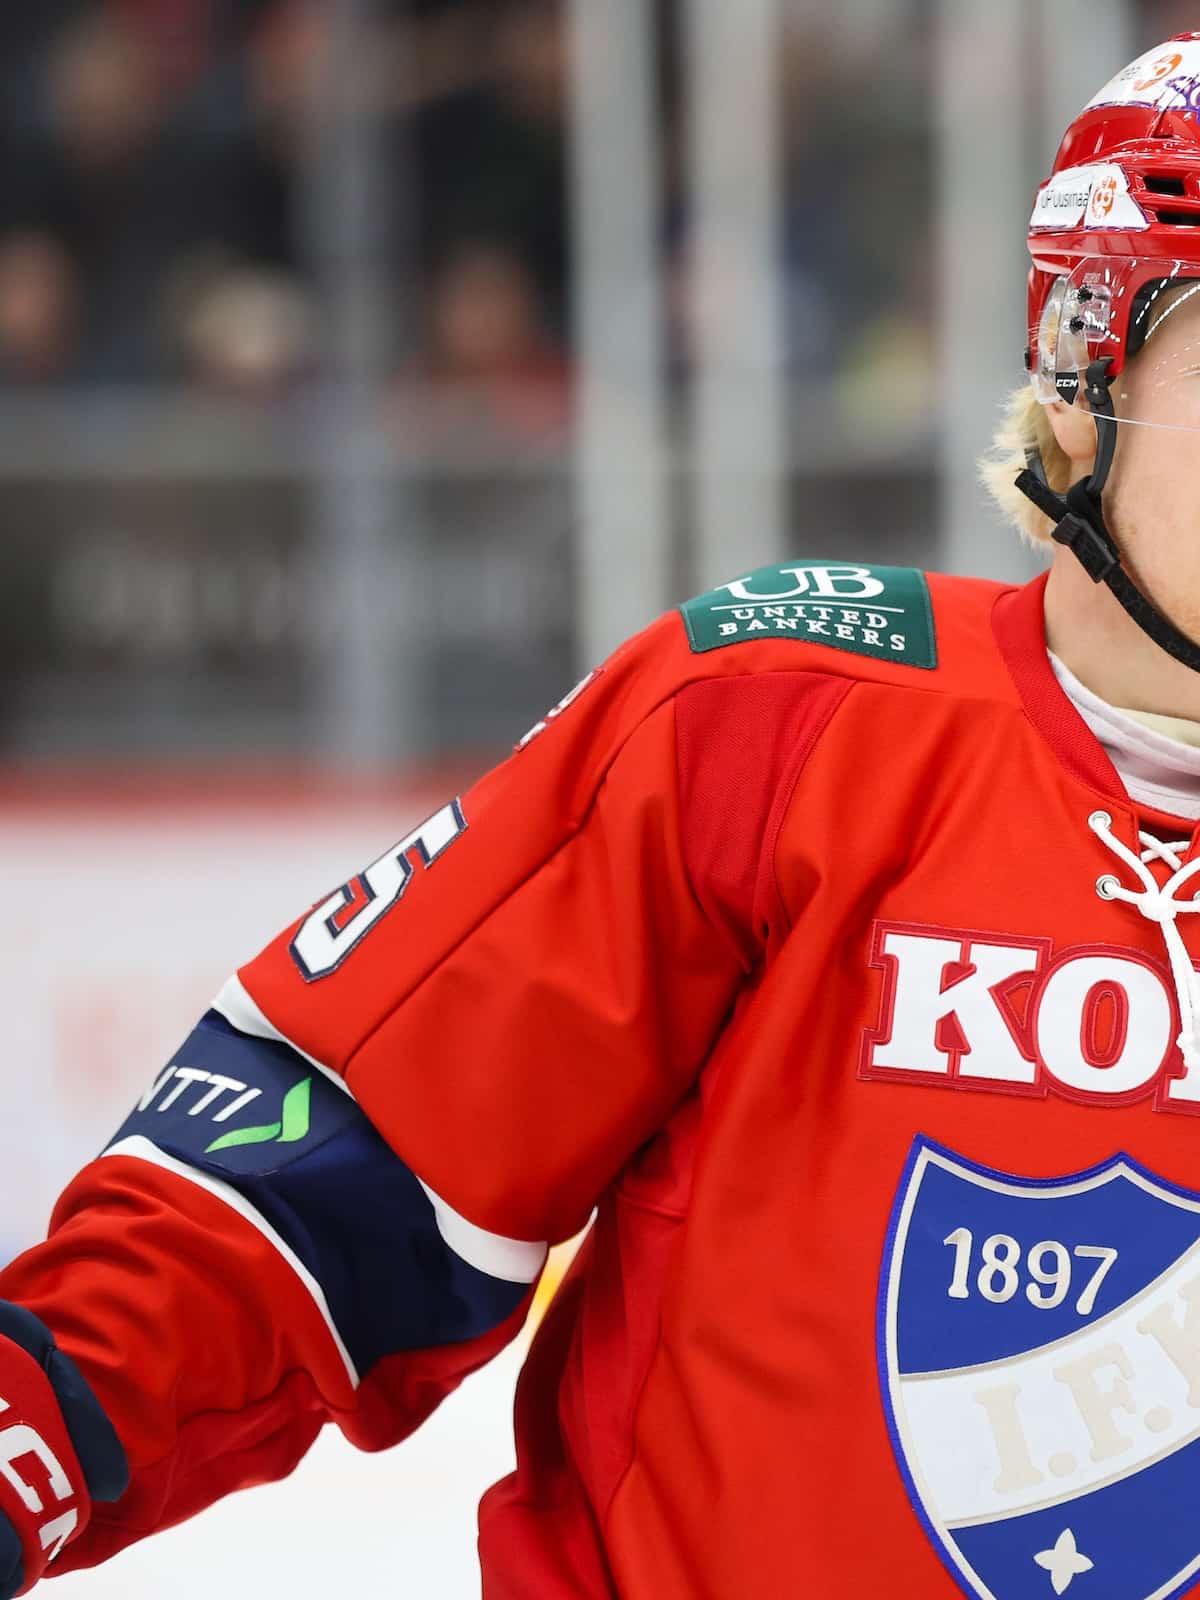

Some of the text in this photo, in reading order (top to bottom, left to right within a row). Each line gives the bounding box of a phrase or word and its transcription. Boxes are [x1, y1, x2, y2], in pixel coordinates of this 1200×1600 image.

[714, 566, 885, 601] UB
[718, 618, 906, 651] BANKERS
[731, 606, 889, 629] UNITED
[942, 1227, 1119, 1316] 1897
